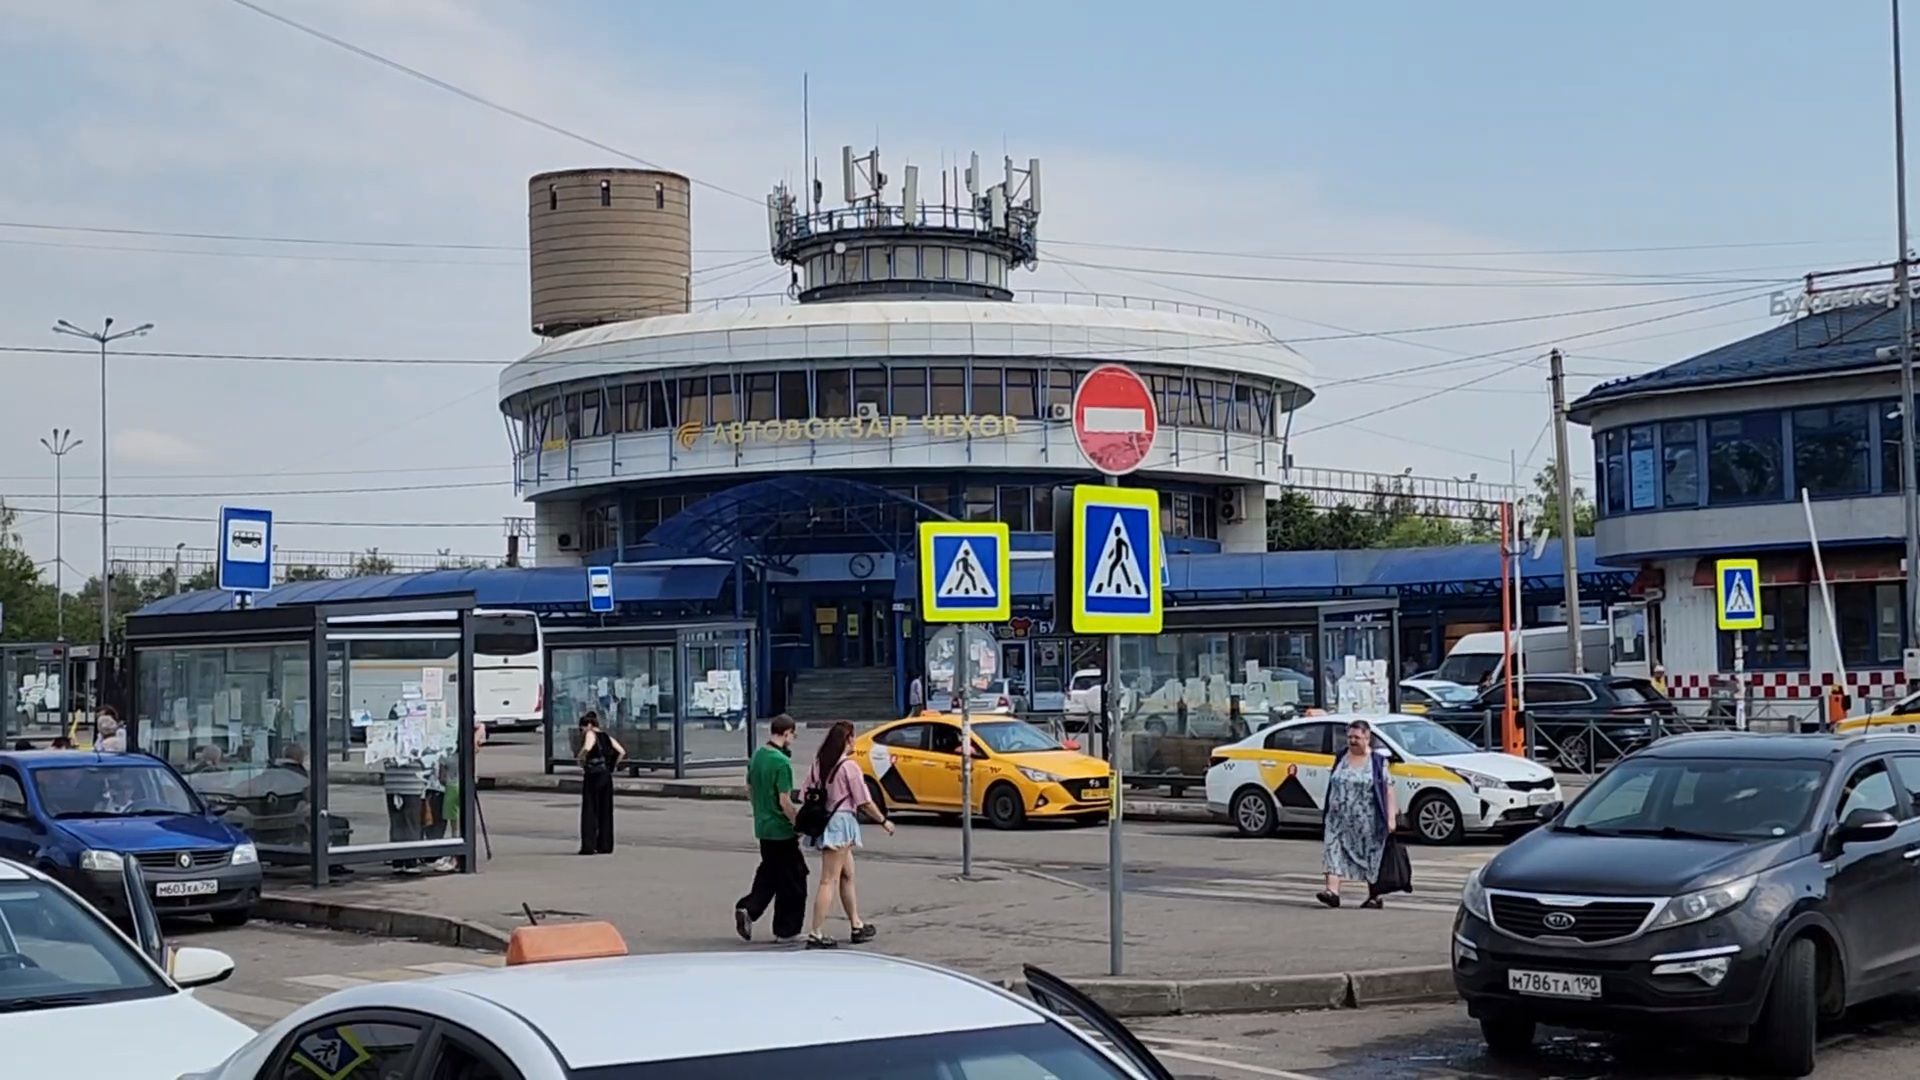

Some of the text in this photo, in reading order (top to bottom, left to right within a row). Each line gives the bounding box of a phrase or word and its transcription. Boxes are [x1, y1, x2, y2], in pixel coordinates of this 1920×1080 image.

[713, 414, 1019, 445] АВТОВОКЗАЛ ЧЕХОВ
[1548, 916, 1569, 926] KIA
[1512, 973, 1598, 993] М786ТА 190
